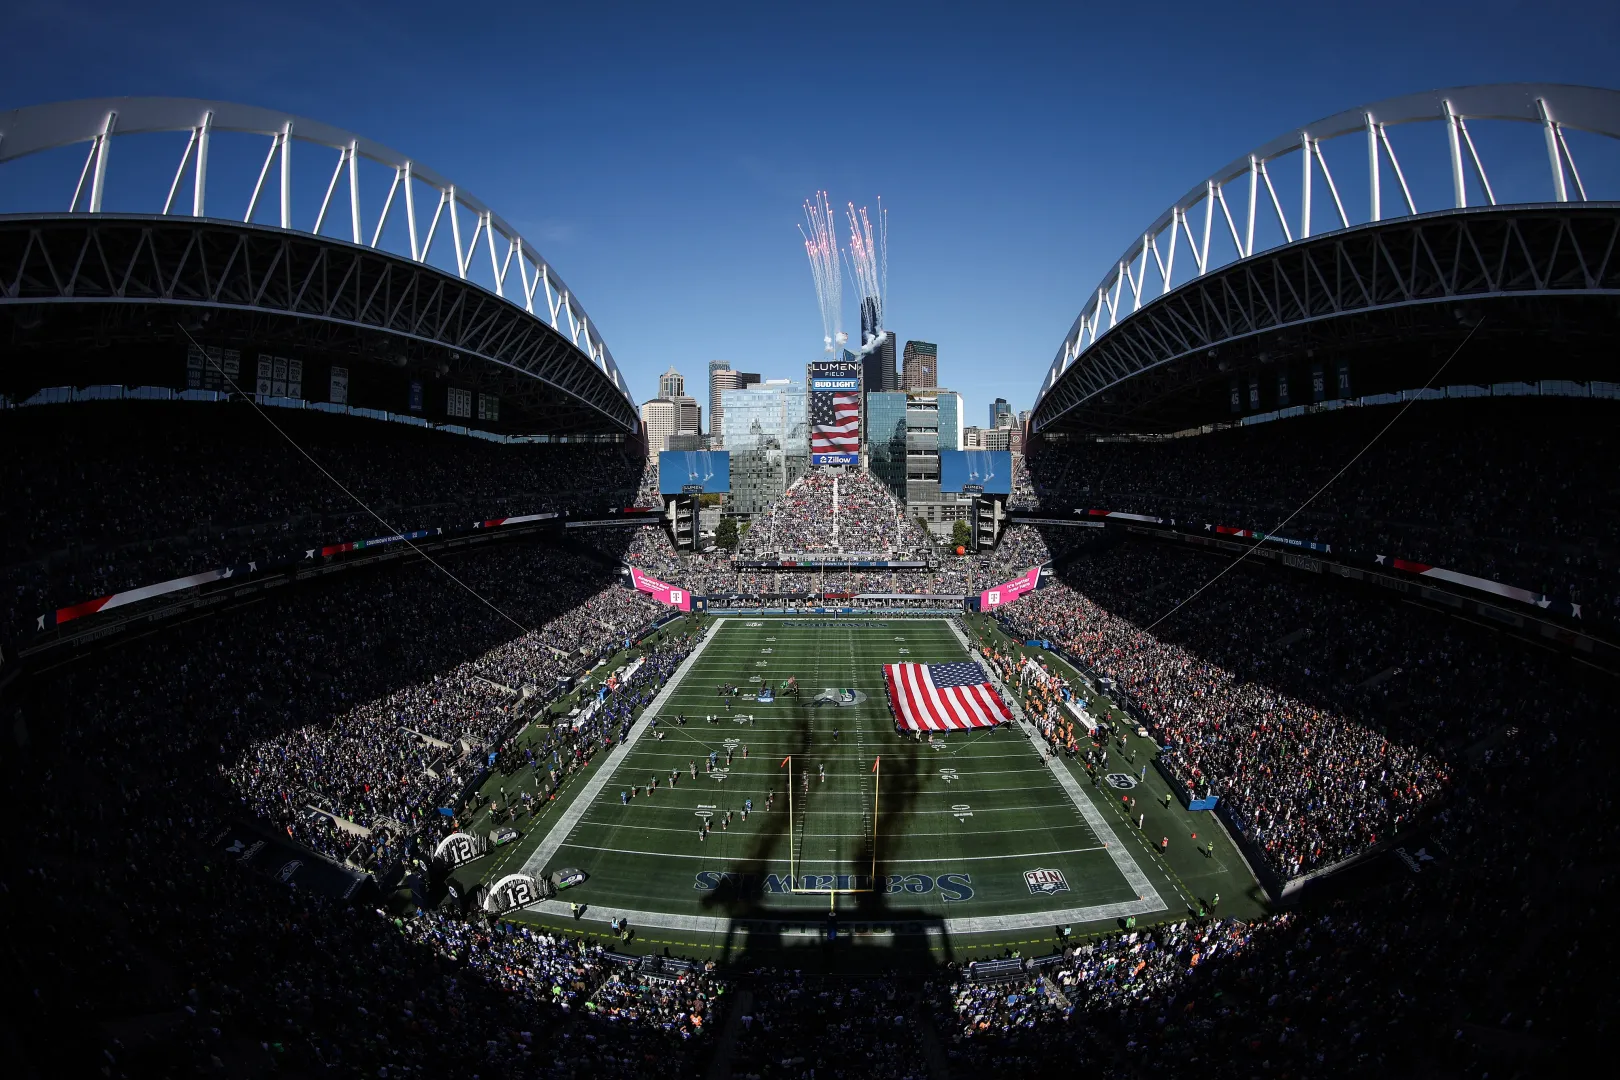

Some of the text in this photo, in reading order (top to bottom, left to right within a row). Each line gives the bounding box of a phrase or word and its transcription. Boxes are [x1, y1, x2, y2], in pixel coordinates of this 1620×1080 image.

[812, 363, 857, 371] LUMEN
[1314, 379, 1324, 392] 96
[1340, 375, 1349, 388] 71
[1280, 384, 1288, 396] 12
[451, 840, 472, 863] 12
[1028, 871, 1060, 884] NFL
[506, 883, 530, 908] 12
